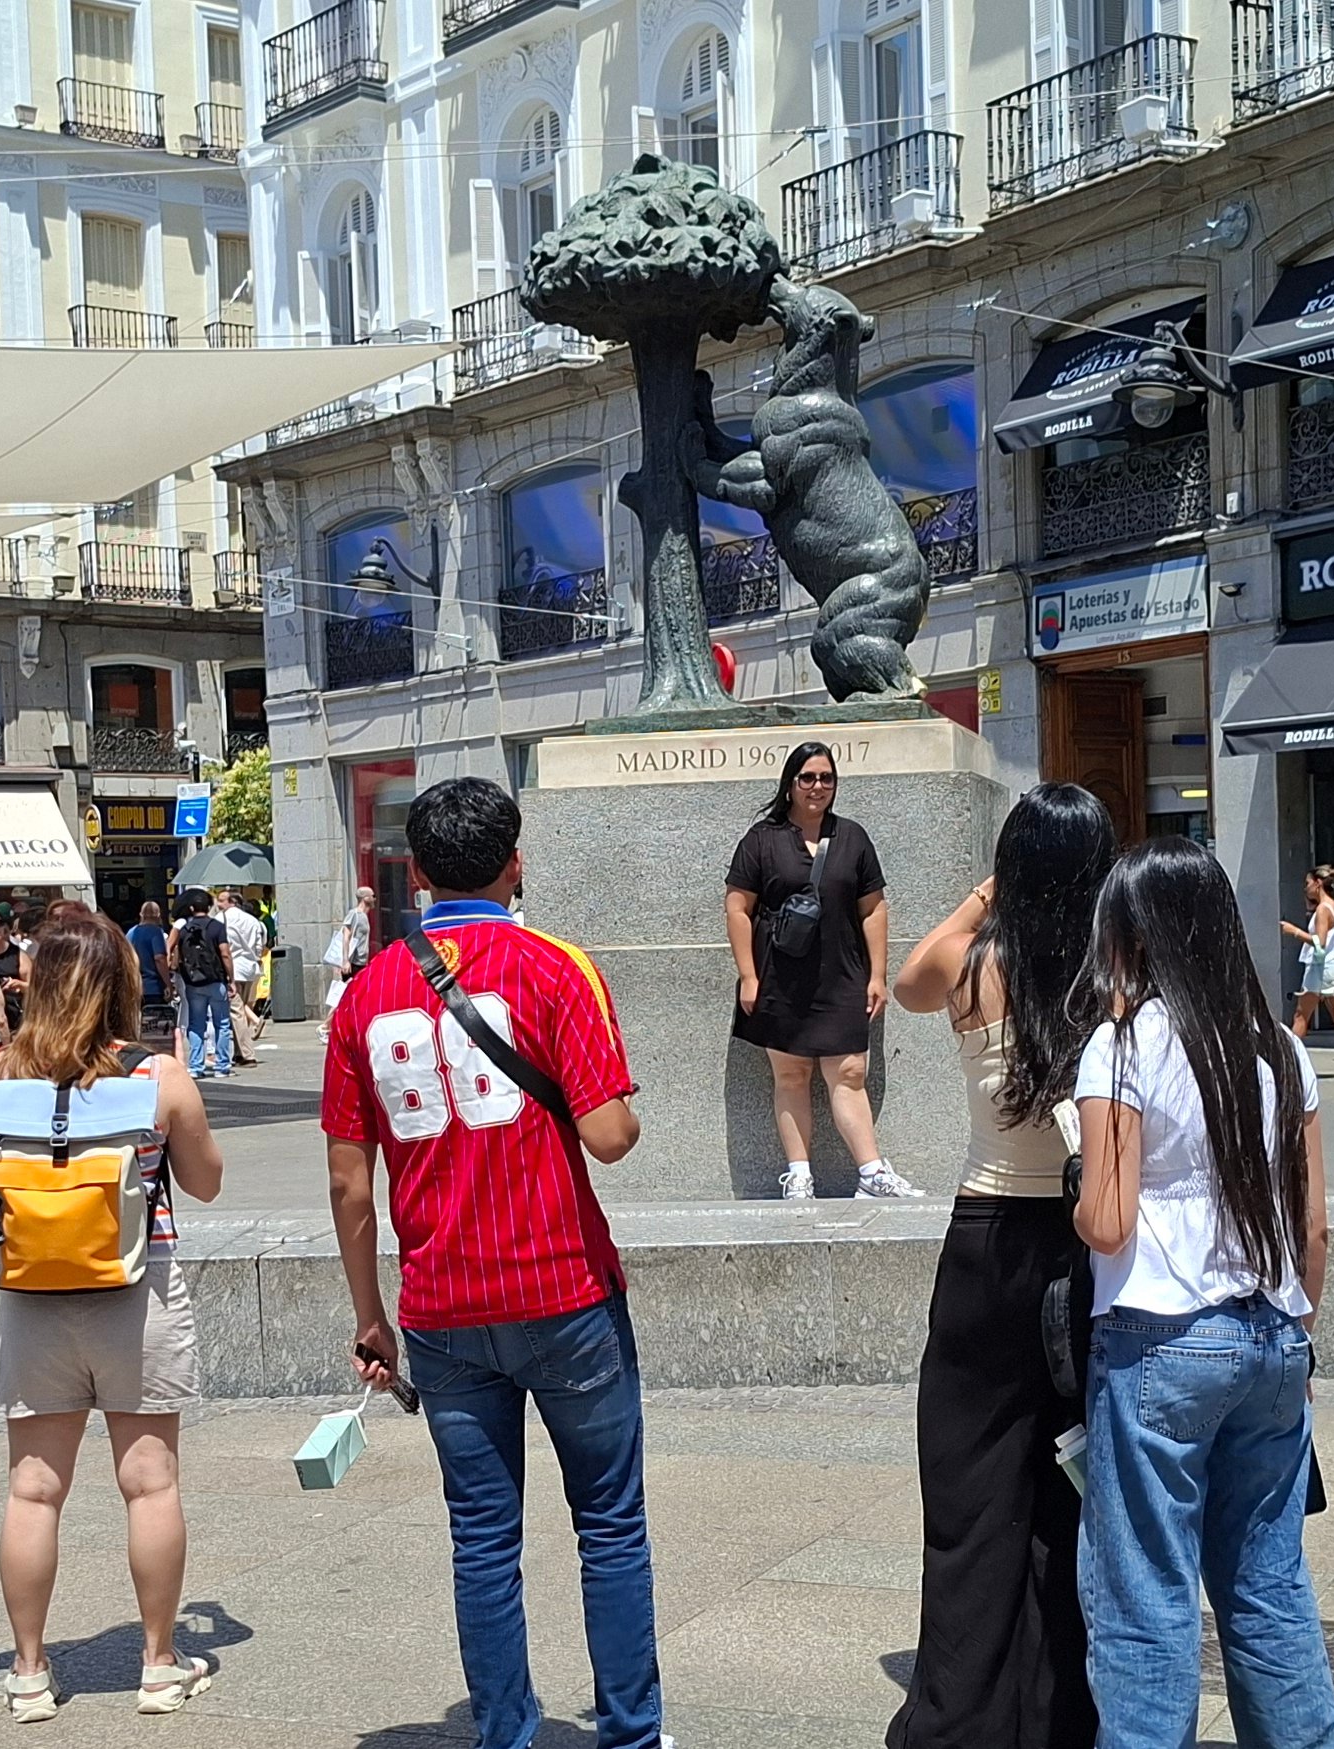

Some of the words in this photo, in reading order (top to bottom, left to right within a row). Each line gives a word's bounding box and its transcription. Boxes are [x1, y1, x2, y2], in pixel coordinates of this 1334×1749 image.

[1051, 349, 1139, 387] RODILLA
[1044, 415, 1093, 438] RODILLA
[1069, 588, 1120, 611] Loterías
[1123, 588, 1131, 606] y
[1069, 608, 1127, 632] Apuestas
[1130, 601, 1151, 621] del
[1154, 594, 1200, 617] Estado
[617, 747, 727, 773] MADRID
[738, 744, 790, 767] 1967
[832, 741, 871, 764] 017
[108, 806, 144, 829] COMPRO
[113, 845, 161, 853] EFECTIVO
[365, 990, 526, 1144] 88
